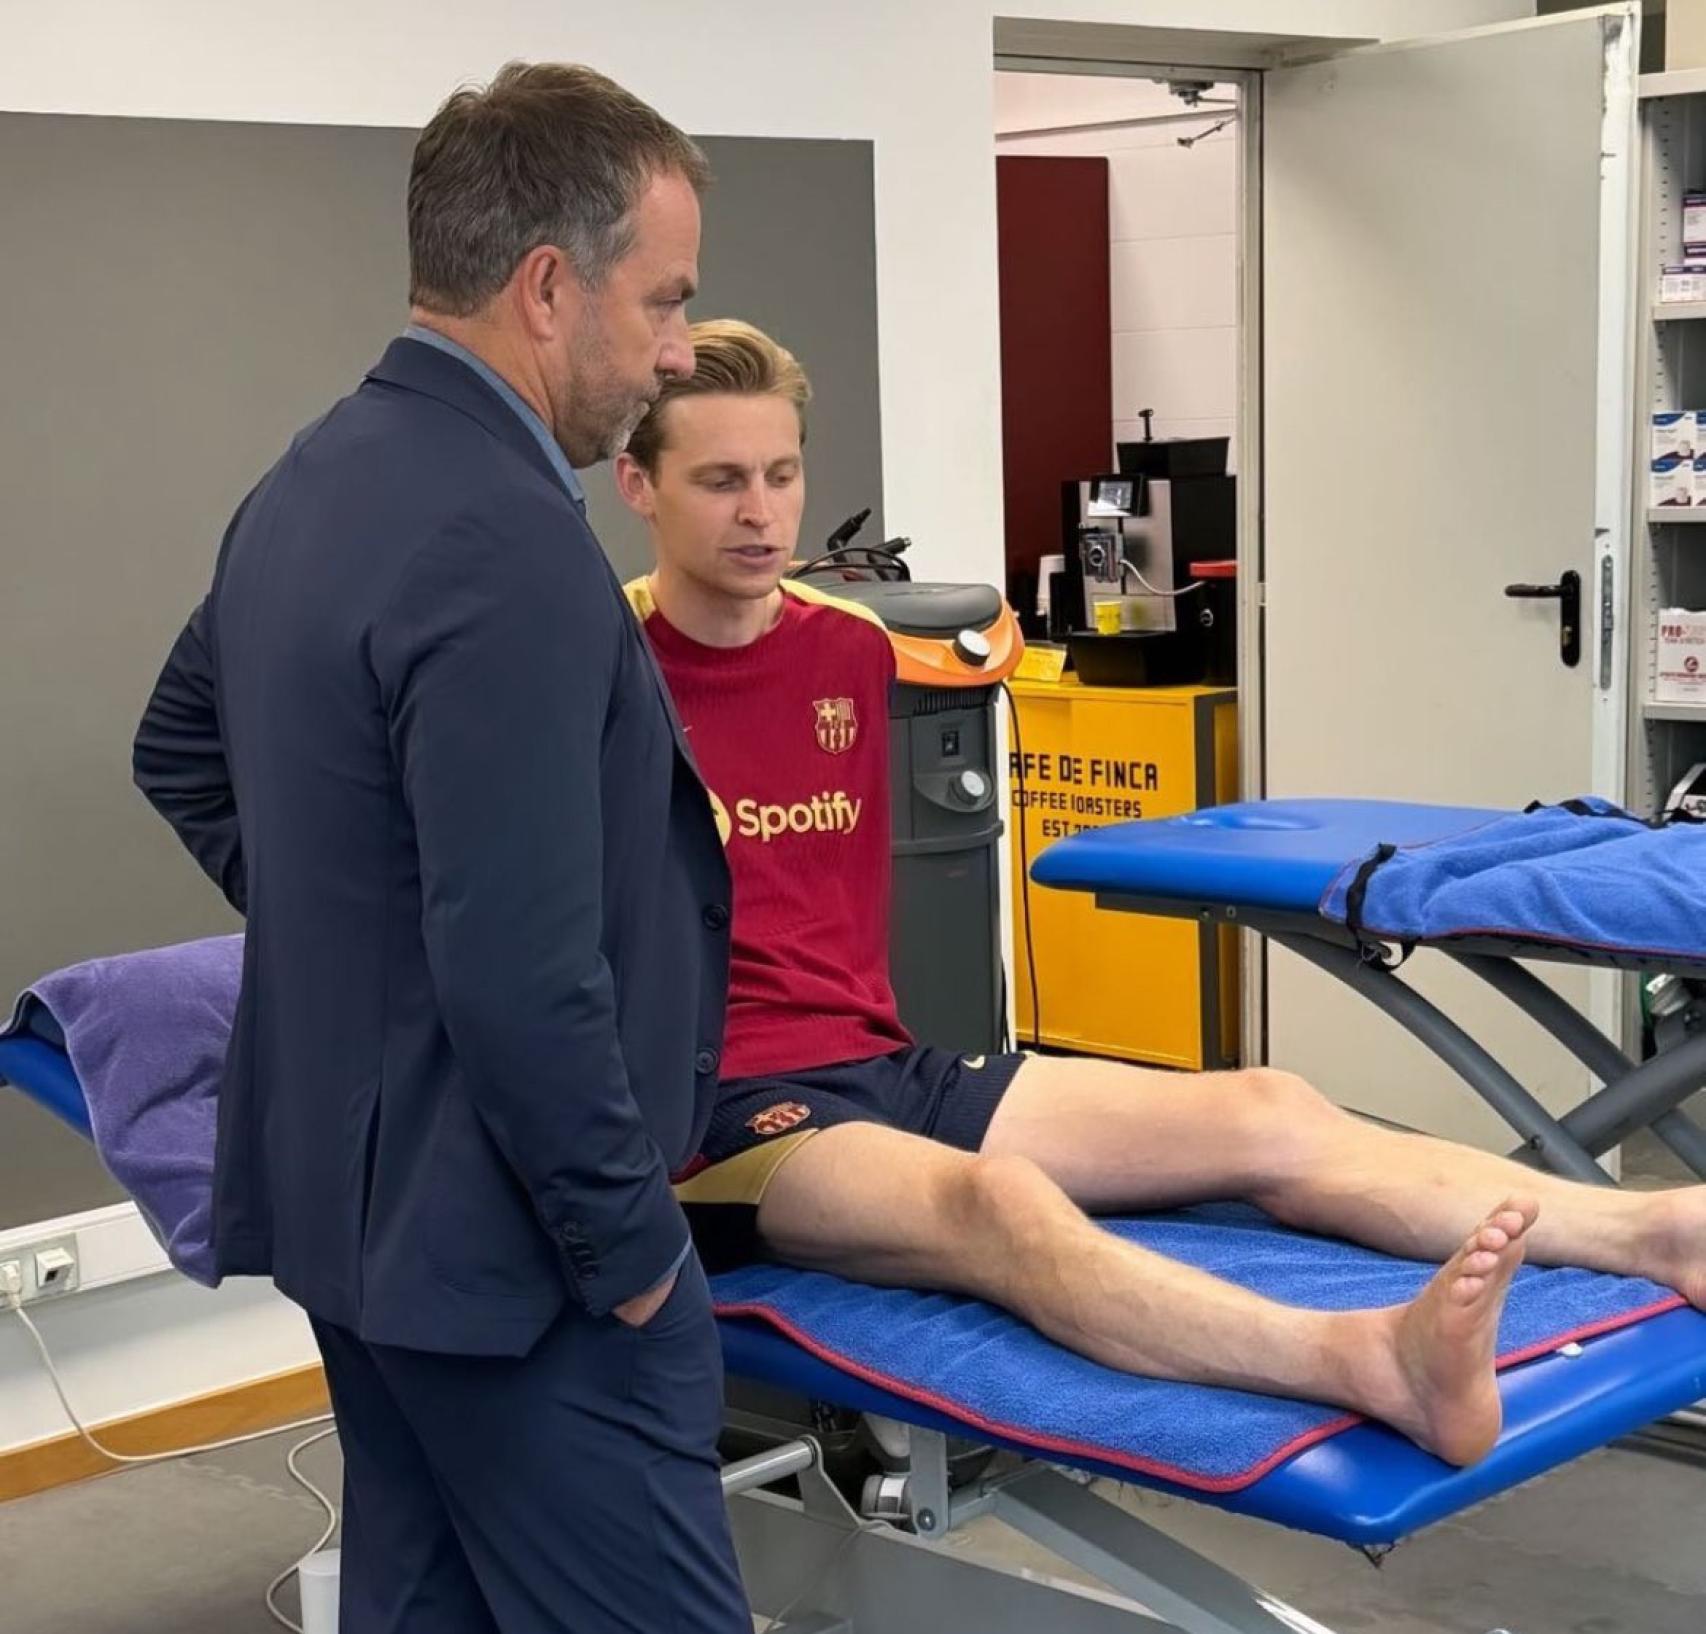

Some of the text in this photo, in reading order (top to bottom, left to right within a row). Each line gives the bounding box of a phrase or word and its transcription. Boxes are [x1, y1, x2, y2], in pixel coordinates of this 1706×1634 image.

[1059, 755, 1083, 785] DE
[1090, 759, 1158, 792] FINCA
[1012, 789, 1067, 810] COFFEE
[736, 791, 862, 842] Spotify
[1043, 819, 1070, 837] EST
